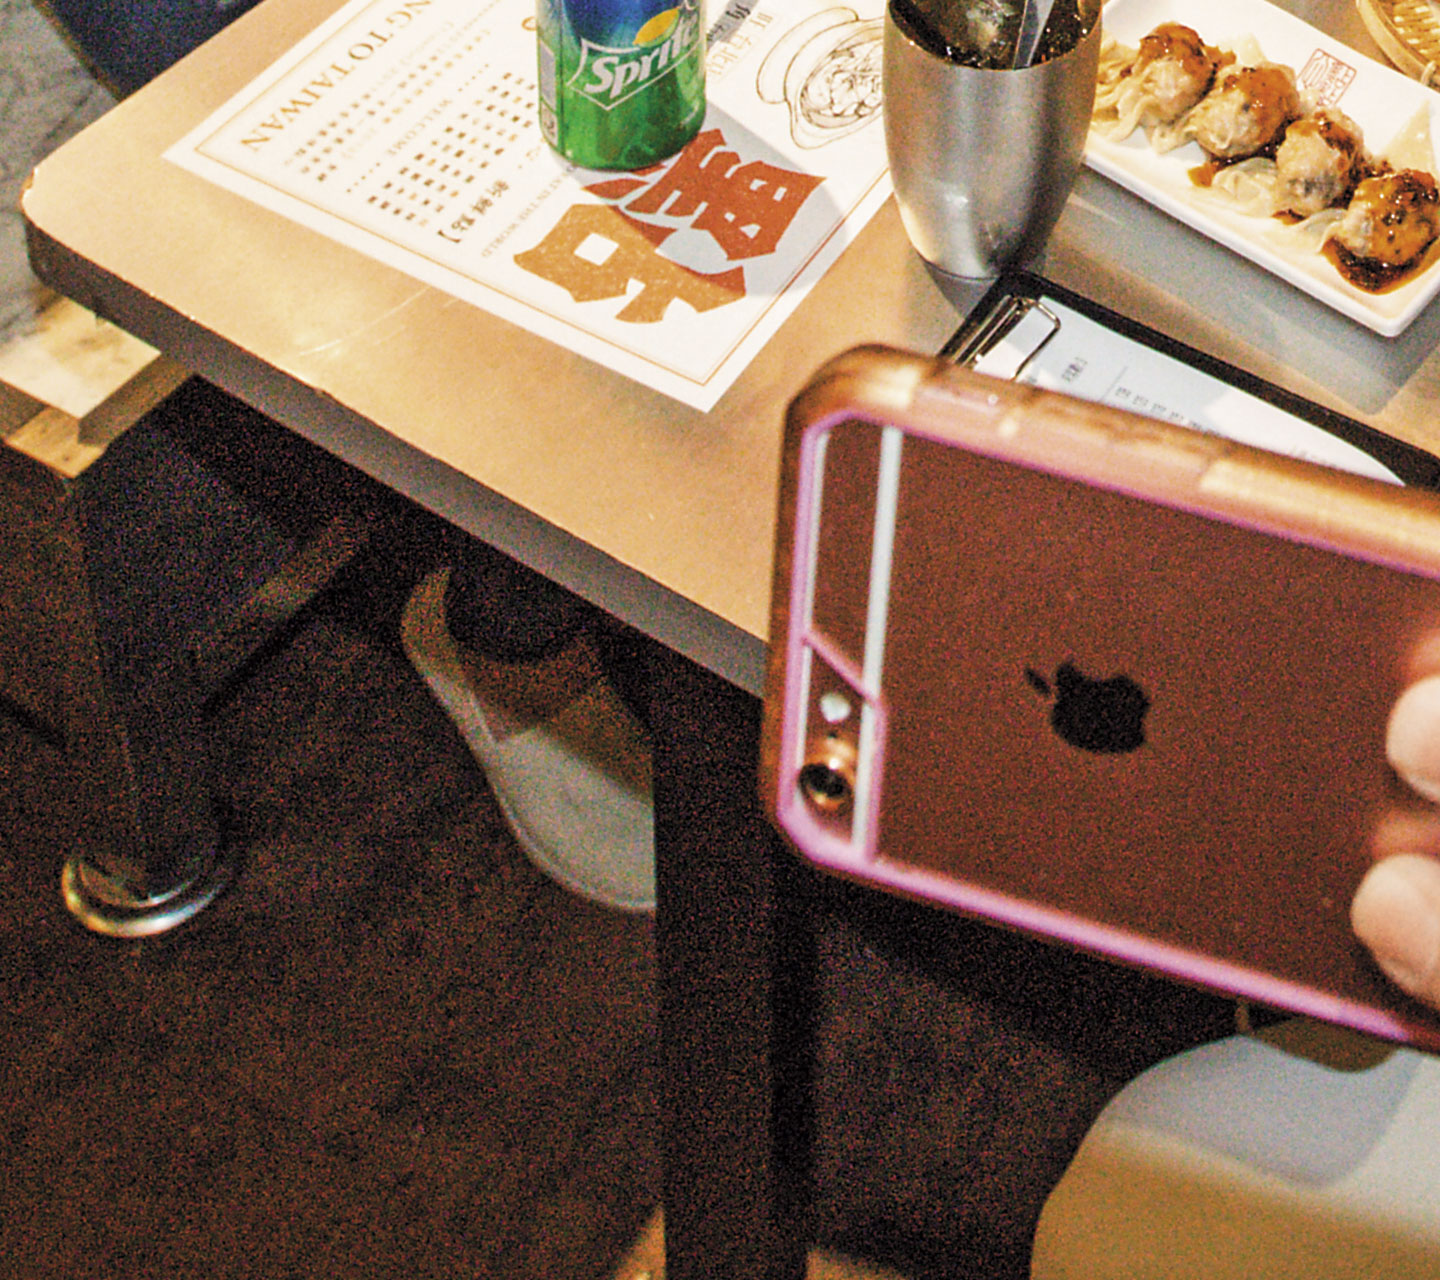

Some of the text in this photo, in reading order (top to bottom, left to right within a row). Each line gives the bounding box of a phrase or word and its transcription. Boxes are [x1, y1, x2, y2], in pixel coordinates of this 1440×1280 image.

[341, 25, 396, 64] TO
[239, 60, 357, 152] TAIWAN
[513, 128, 827, 324] 點
